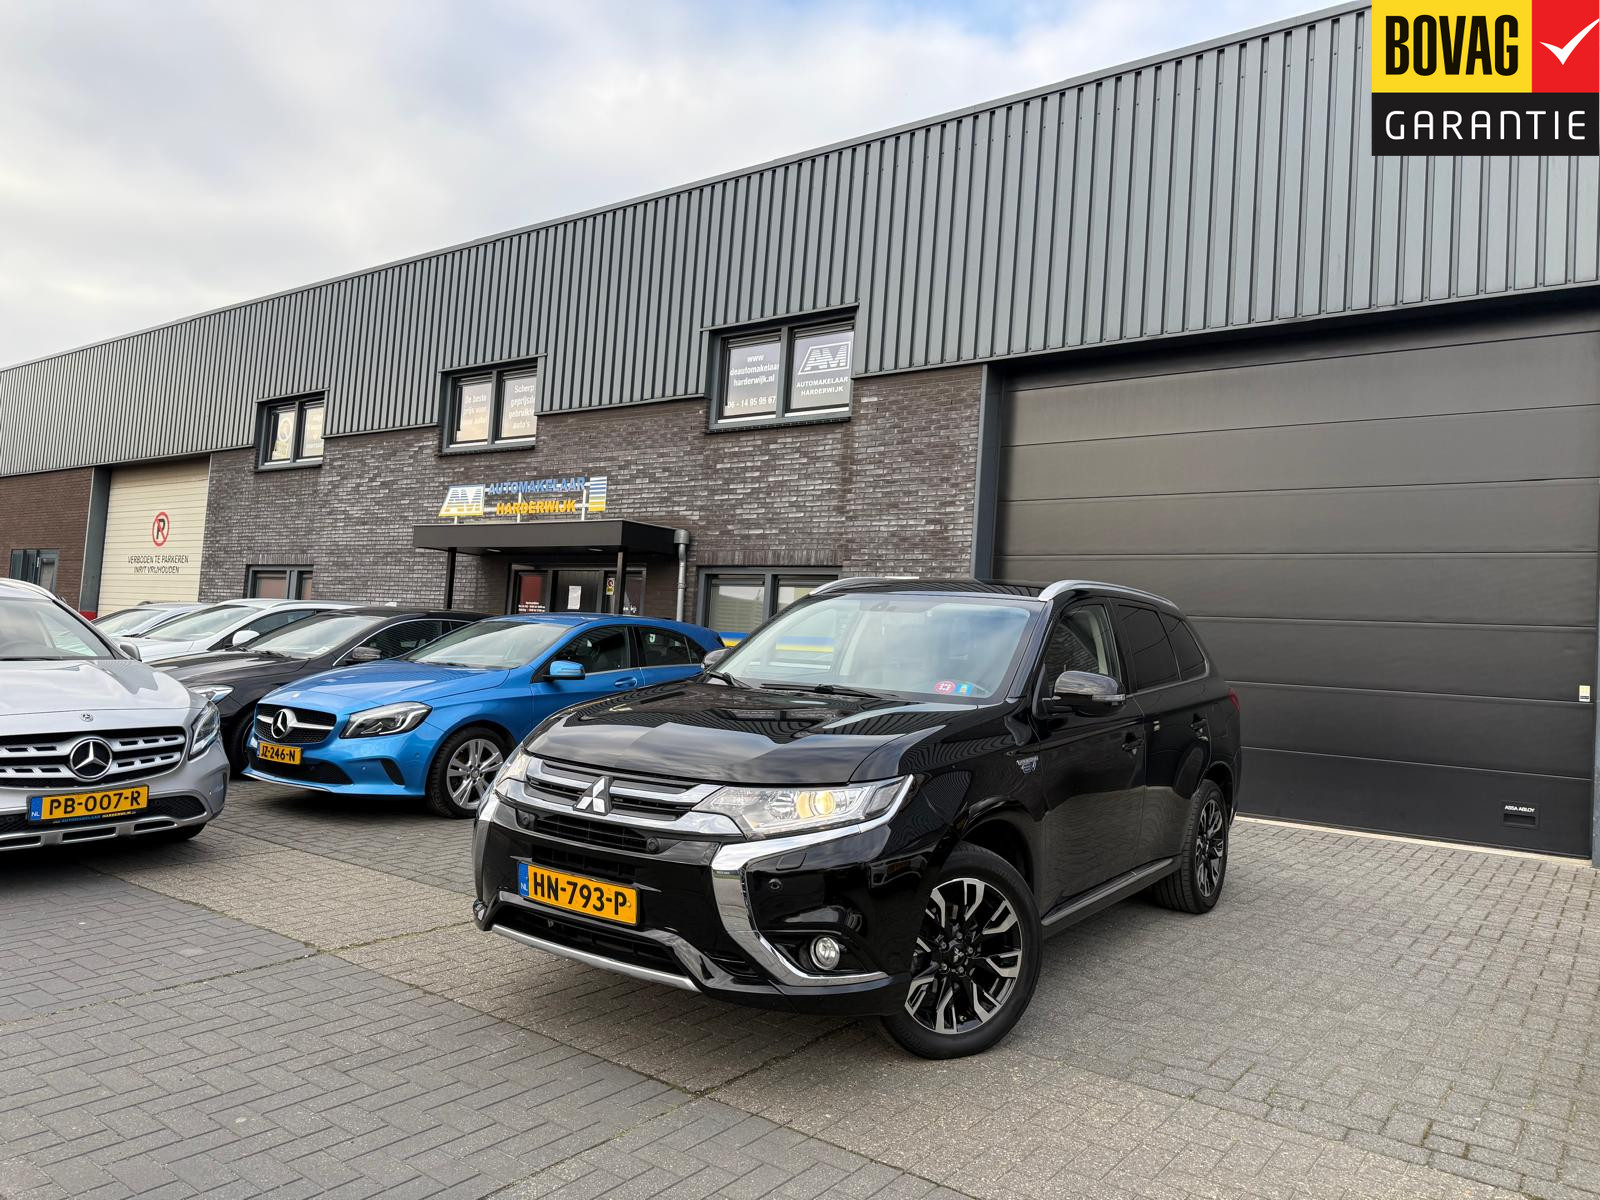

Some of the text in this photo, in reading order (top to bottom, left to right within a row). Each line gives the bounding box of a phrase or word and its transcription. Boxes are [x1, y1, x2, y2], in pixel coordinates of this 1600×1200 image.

[733, 373, 775, 387] harderwijk.nl
[796, 376, 849, 388] AUTOMAKELAAR
[801, 386, 844, 396] HARDERWIJK
[488, 477, 586, 495] AUTOMAKELAAR
[496, 499, 577, 515] HARDERWIJK
[128, 554, 189, 564] VERBODEN TE PARKEREN
[261, 745, 296, 762] JZ-246-N
[49, 790, 141, 815] PB-007-R
[520, 871, 627, 916] NL HN-793-P
